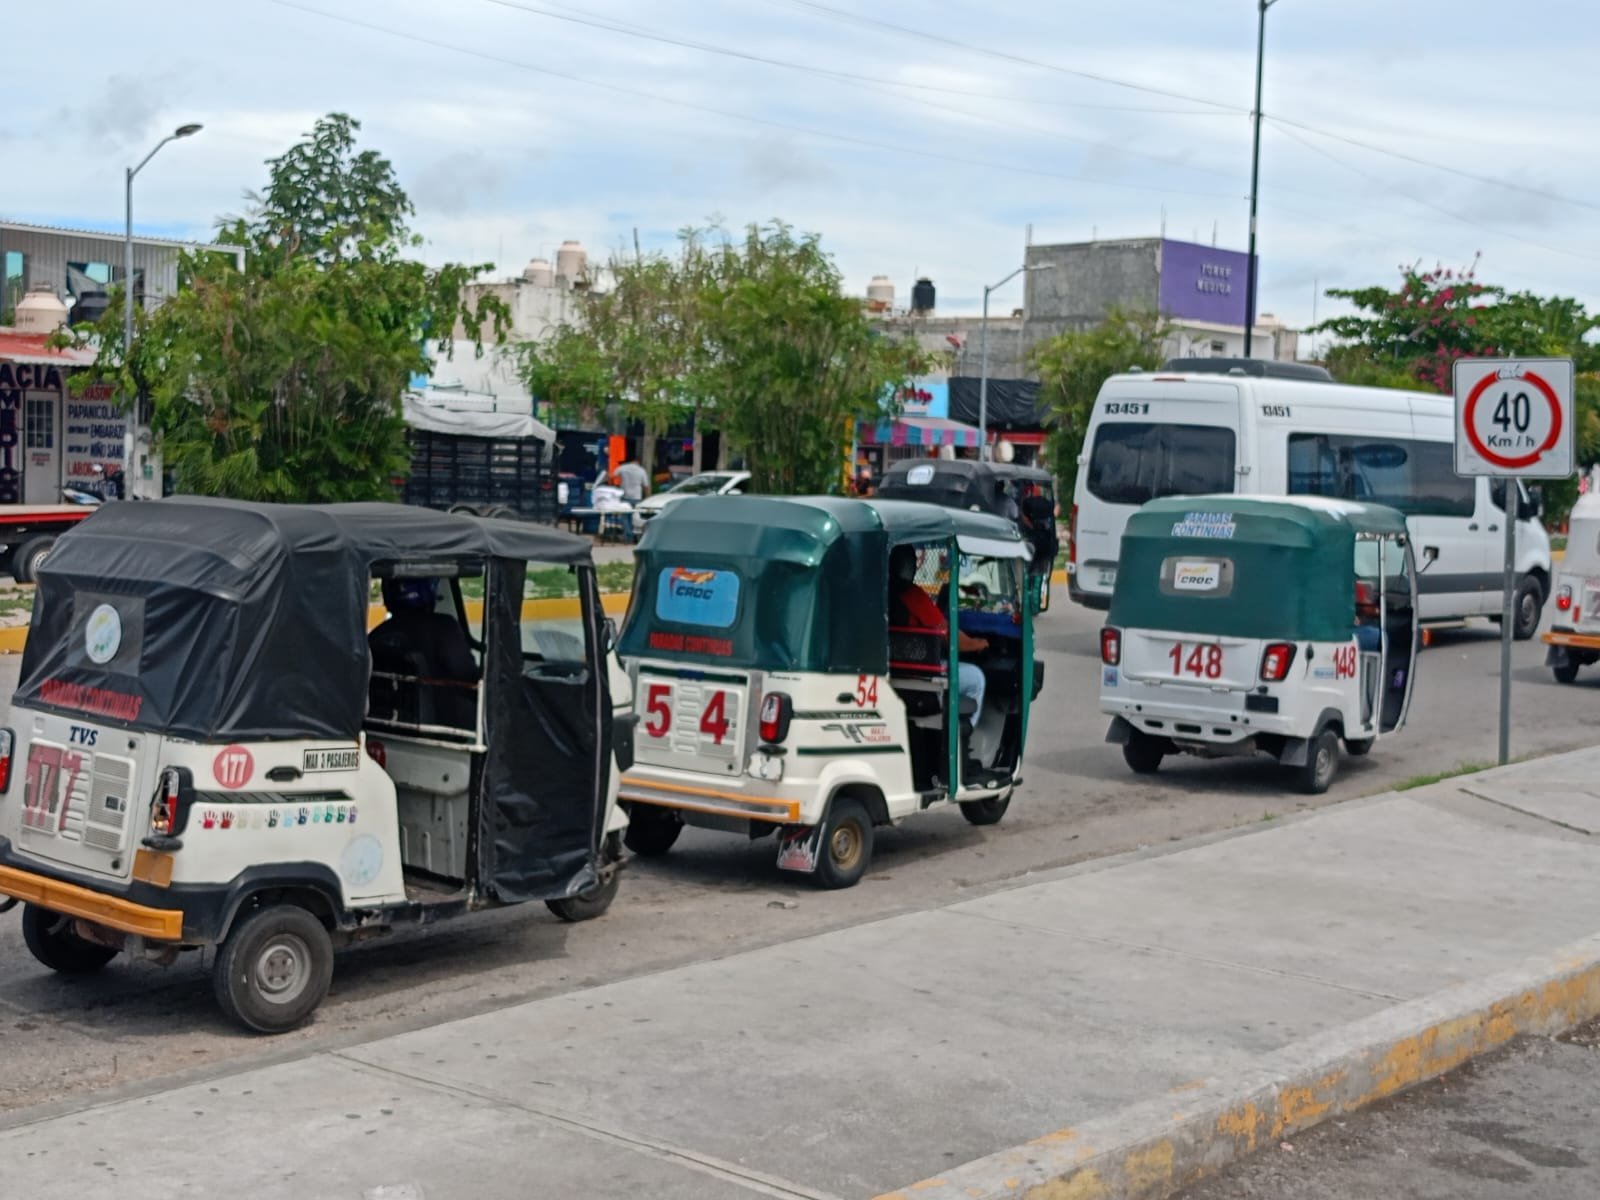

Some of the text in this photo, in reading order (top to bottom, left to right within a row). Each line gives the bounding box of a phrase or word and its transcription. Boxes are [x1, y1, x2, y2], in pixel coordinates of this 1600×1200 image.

[1104, 402, 1150, 415] 13451
[1261, 405, 1292, 418] 13451
[1492, 391, 1531, 433] 40
[1172, 523, 1235, 539] CONTINUAS
[1180, 575, 1214, 585] CROC
[675, 586, 714, 600] CROC
[1168, 641, 1223, 679] 148
[1333, 645, 1356, 680] 148
[855, 673, 878, 709] 54
[69, 725, 98, 746] TVS
[220, 752, 248, 785] 177
[327, 751, 359, 768] PASAJEROS
